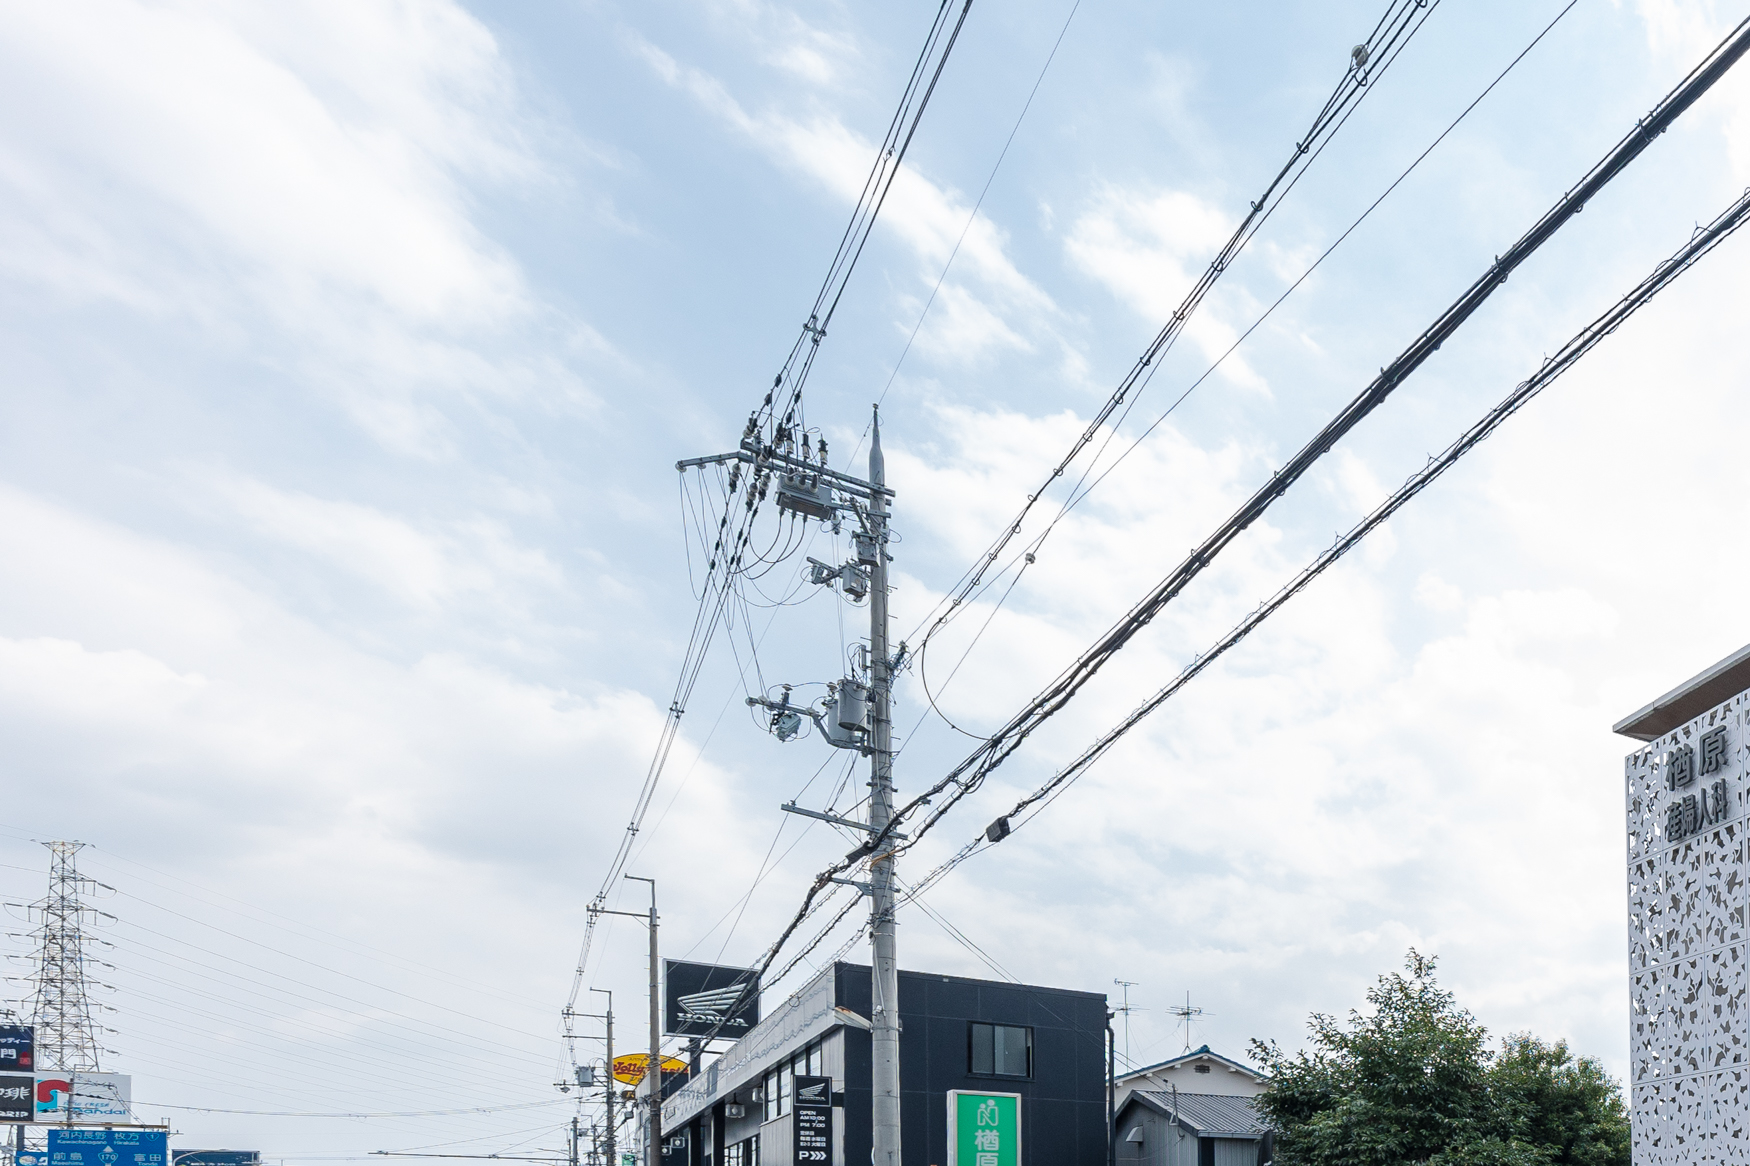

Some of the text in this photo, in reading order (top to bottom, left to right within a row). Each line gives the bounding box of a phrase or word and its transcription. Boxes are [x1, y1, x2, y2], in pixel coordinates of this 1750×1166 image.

[1665, 724, 1727, 791] 楢原
[1665, 778, 1729, 843] 産婦人科
[613, 1061, 645, 1077] Jolly
[58, 1131, 107, 1140] 河内長野
[114, 1132, 140, 1140] 枚方
[53, 1152, 83, 1161] 前島
[133, 1153, 162, 1162] 富田
[798, 1150, 810, 1160] P
